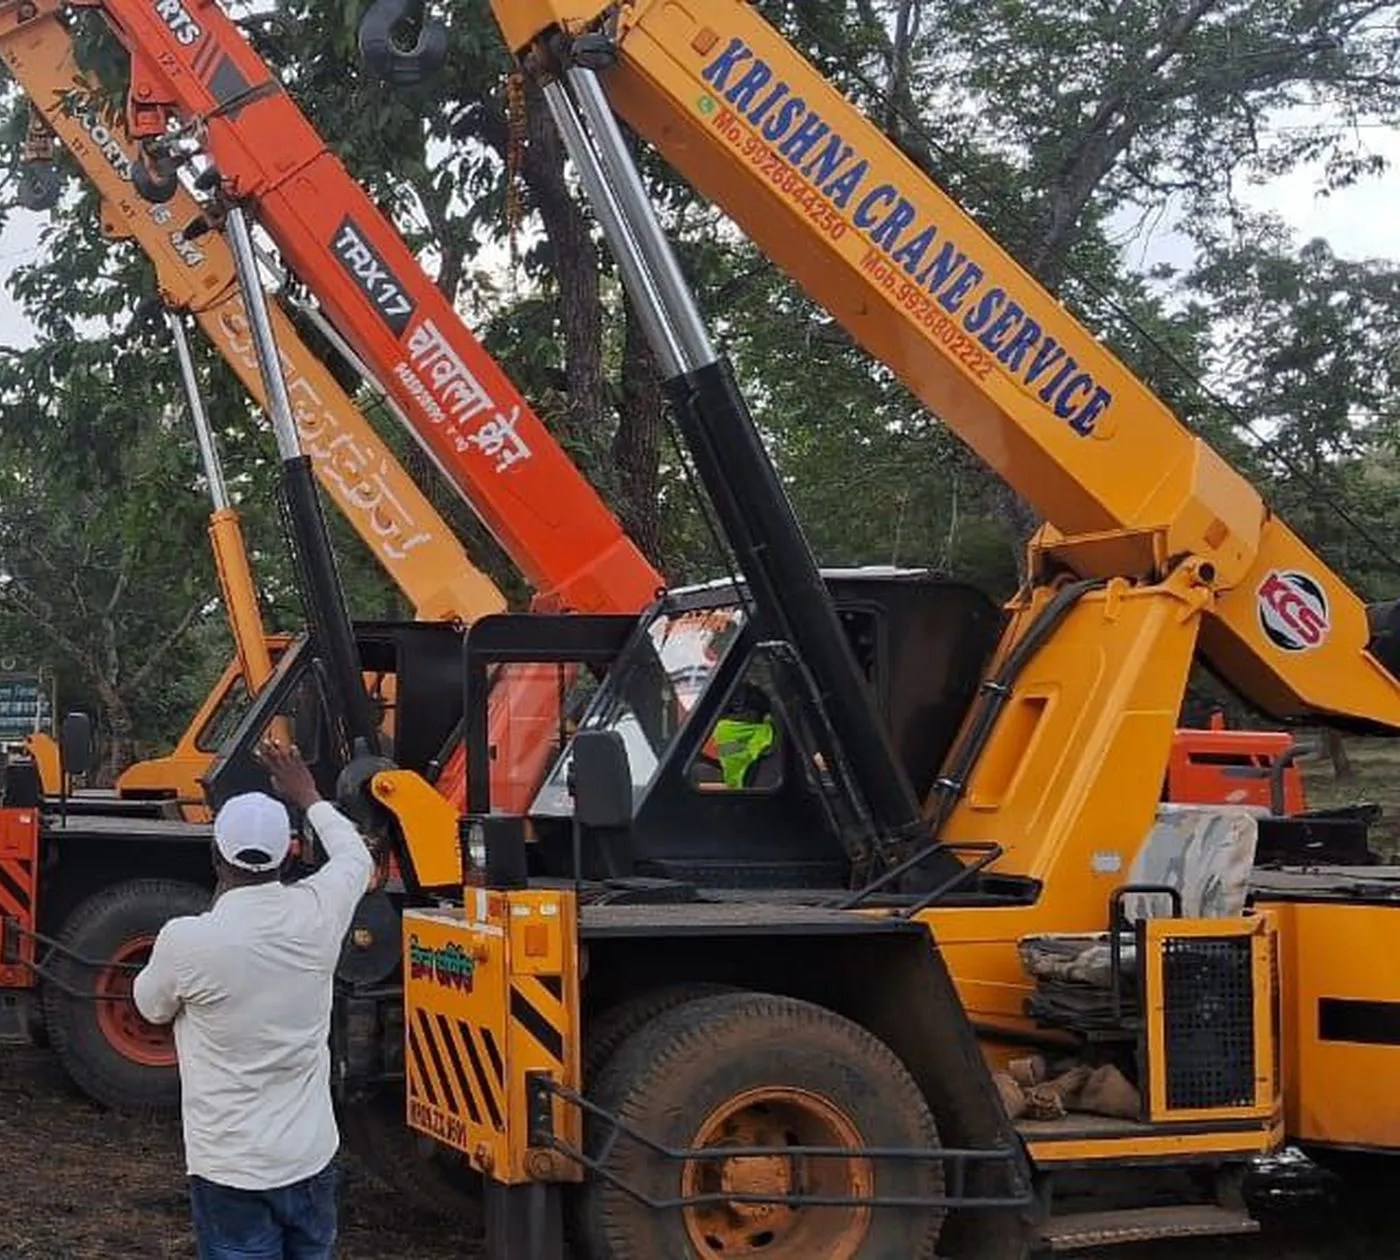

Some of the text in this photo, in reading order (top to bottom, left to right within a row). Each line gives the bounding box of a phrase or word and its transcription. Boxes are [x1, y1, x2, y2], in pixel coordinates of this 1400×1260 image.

[702, 38, 1113, 438] KRISHNA CRANE SERVICE
[1256, 573, 1330, 644] KCS
